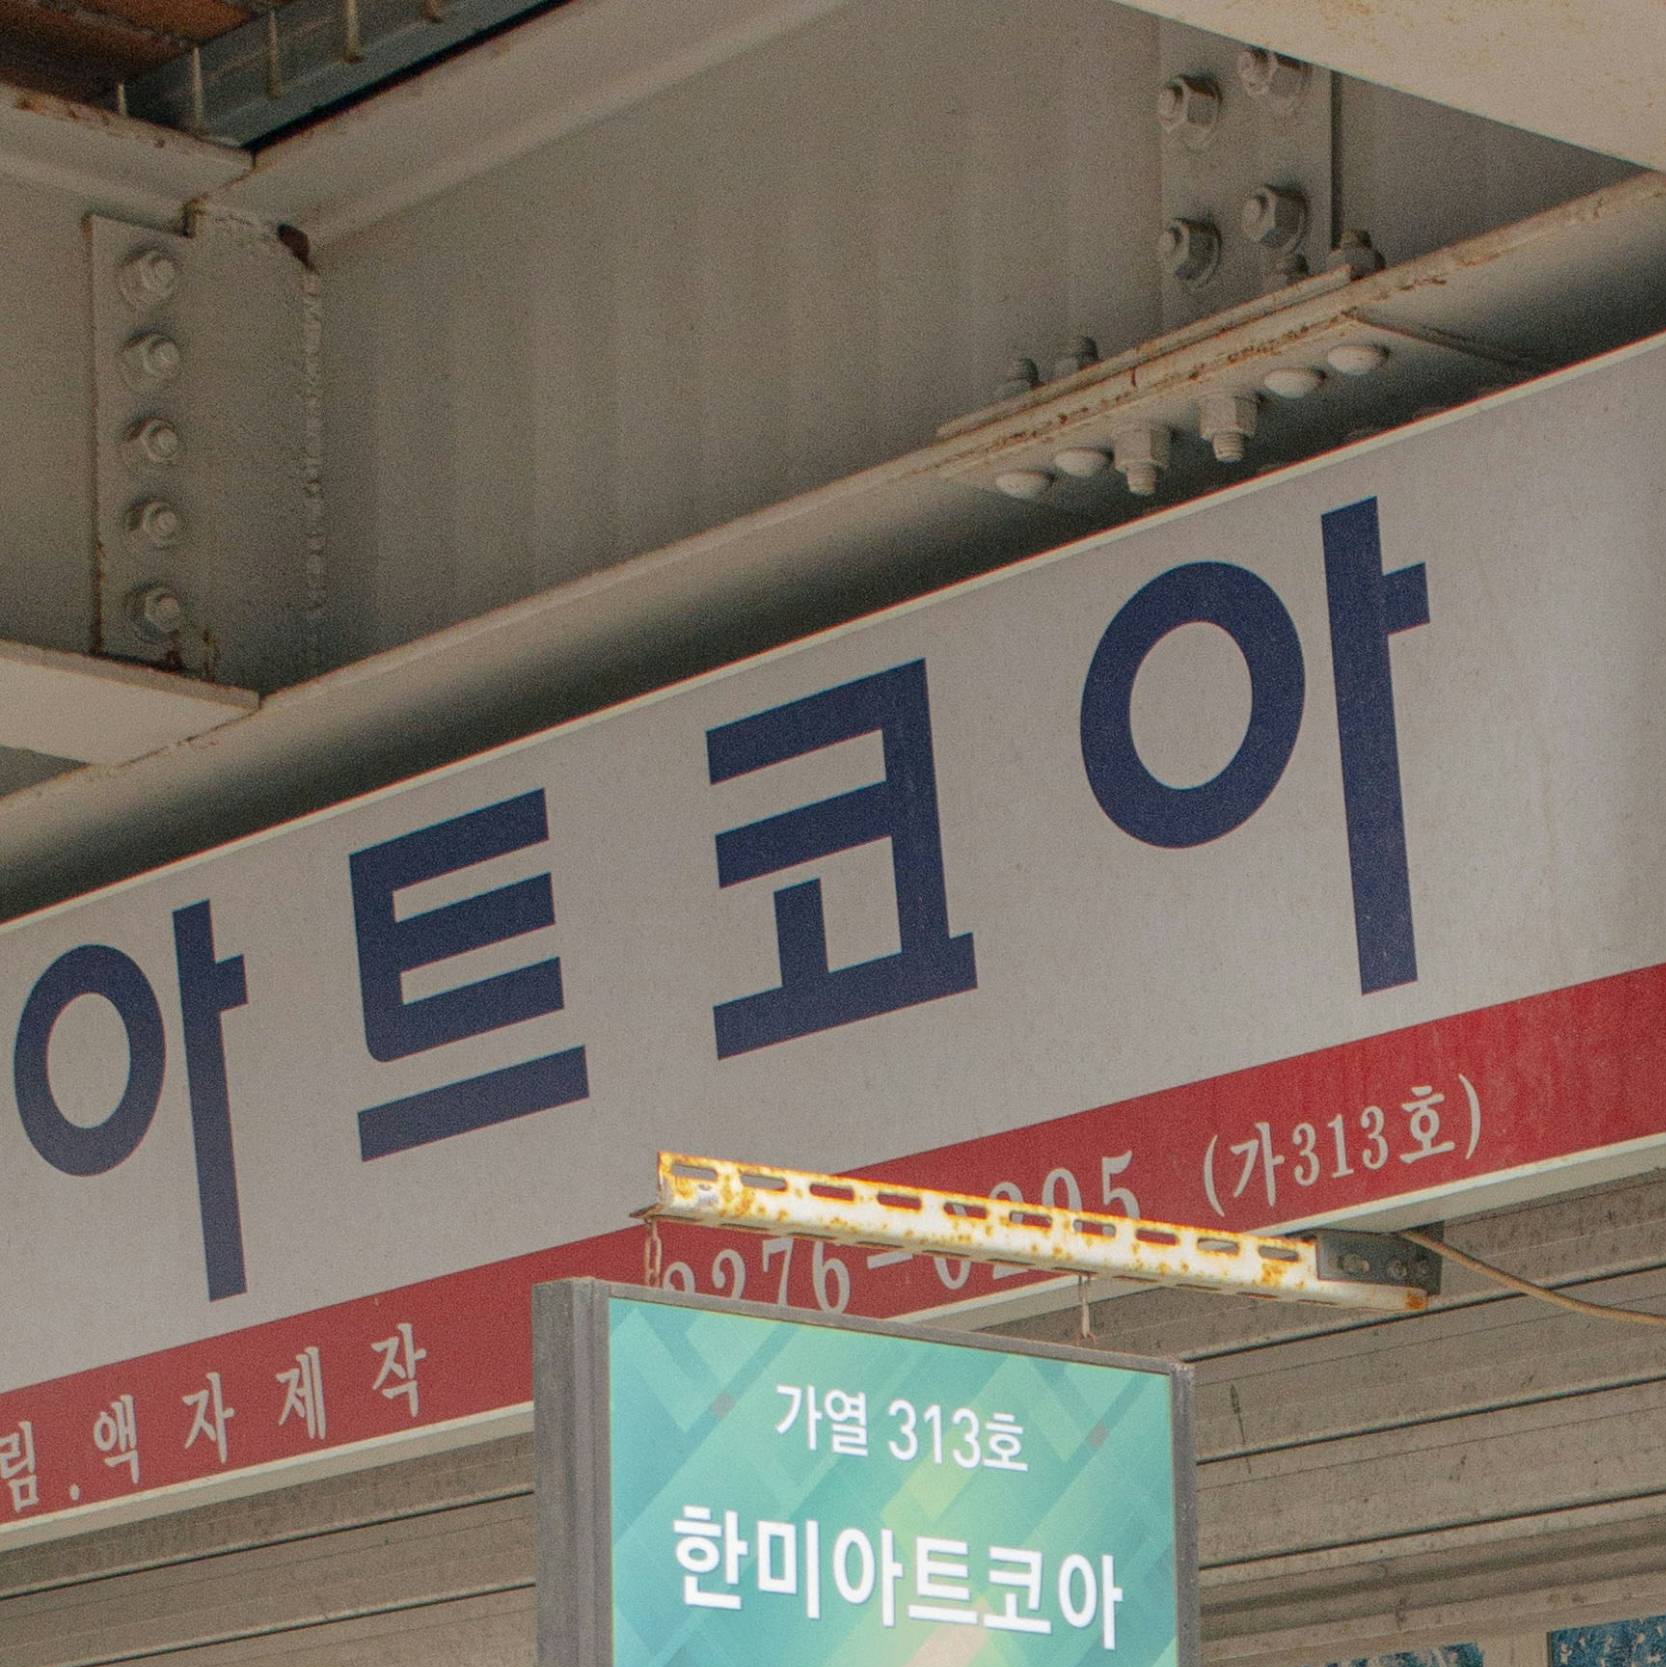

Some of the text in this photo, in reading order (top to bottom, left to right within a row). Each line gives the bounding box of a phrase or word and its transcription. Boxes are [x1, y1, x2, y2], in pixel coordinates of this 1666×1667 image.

[12, 497, 1429, 1301] 아트코아
[1203, 1074, 1481, 1217] (가313호)
[775, 1384, 1029, 1471] 가열 313호
[672, 1505, 1124, 1650] 한미아트코아
